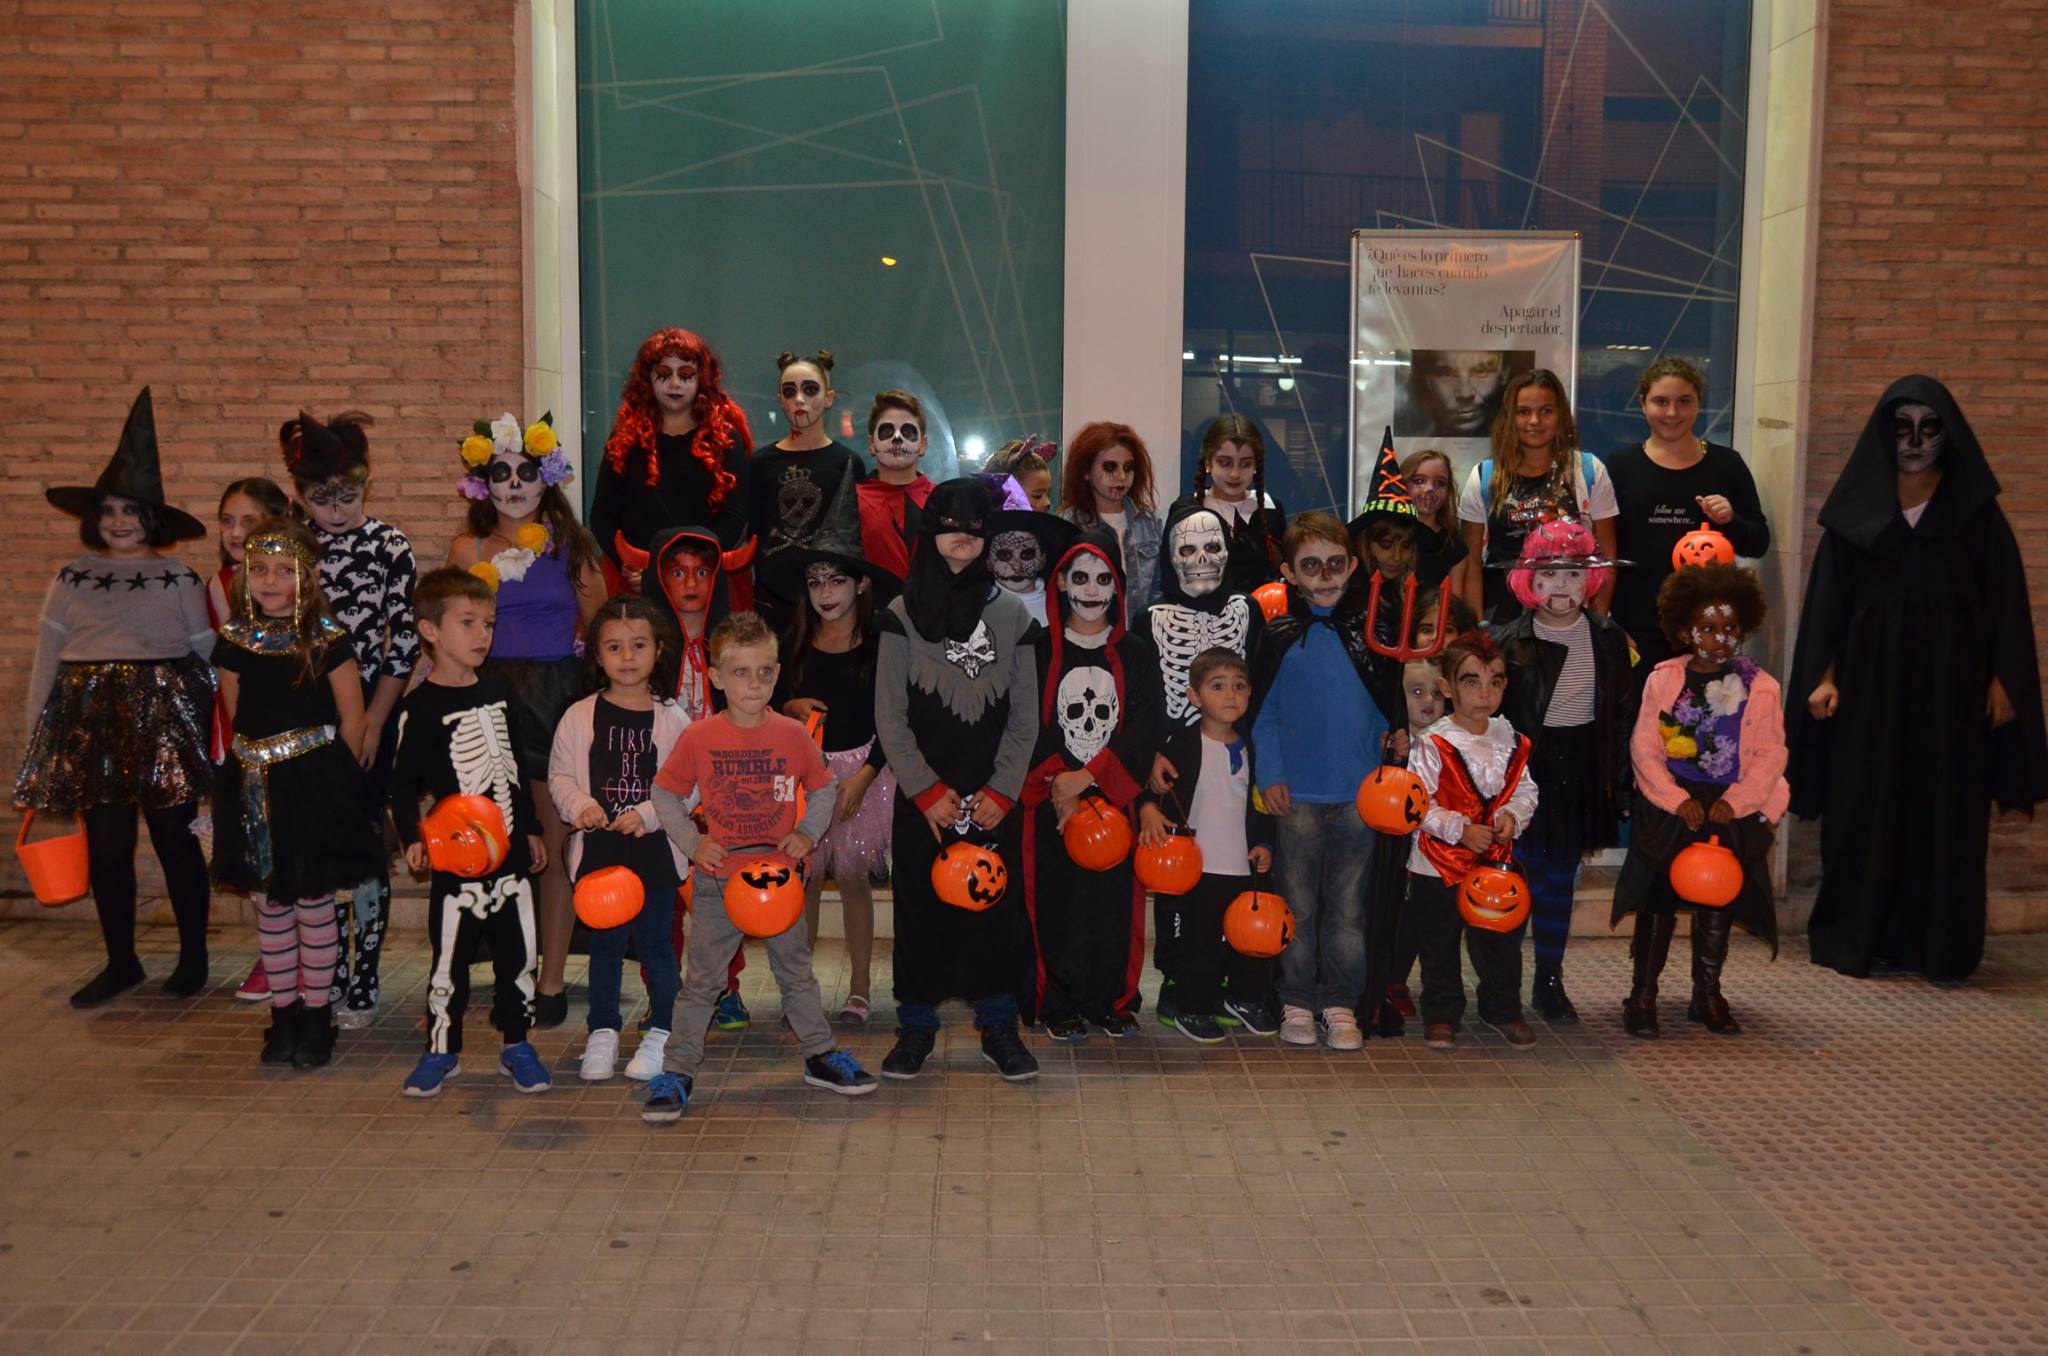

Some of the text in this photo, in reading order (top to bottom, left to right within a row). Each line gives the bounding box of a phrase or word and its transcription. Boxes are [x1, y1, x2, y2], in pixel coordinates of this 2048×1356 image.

[1401, 252, 1418, 263] es
[1419, 248, 1433, 263] lo
[1433, 248, 1489, 266] primero
[1397, 264, 1435, 279] haces
[1437, 265, 1489, 280] cuando
[1384, 281, 1446, 296] levantas?
[1500, 304, 1562, 322] Apagar el
[1481, 319, 1563, 339] despertador.
[622, 752, 640, 778] BE
[712, 758, 787, 776] RUMBLE
[773, 775, 795, 802] 51
